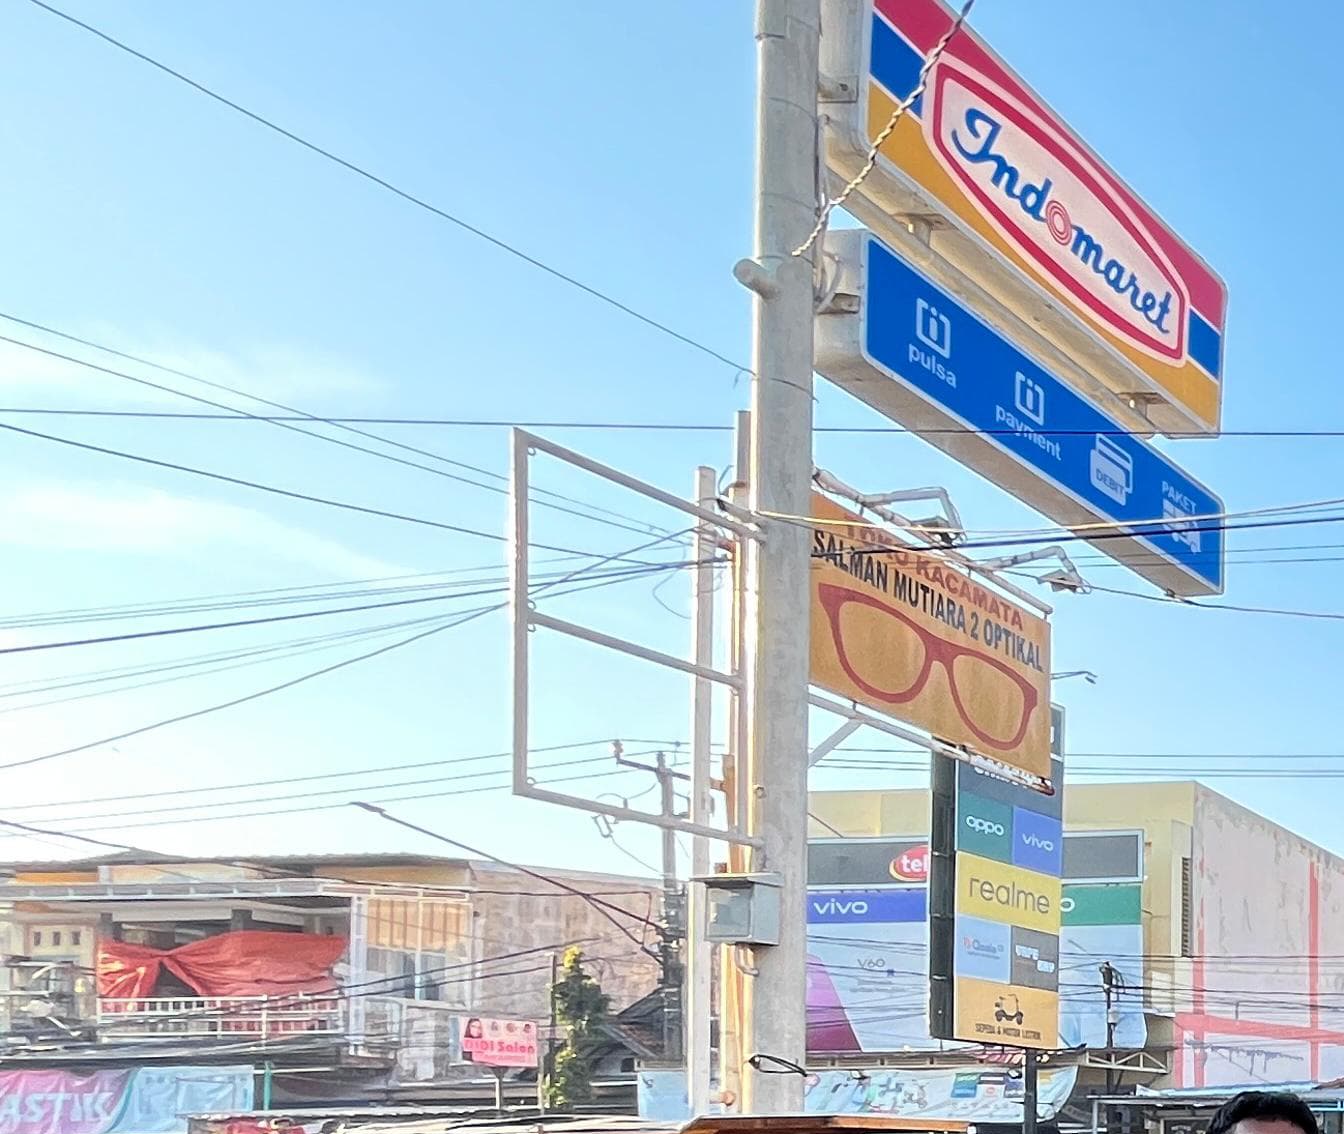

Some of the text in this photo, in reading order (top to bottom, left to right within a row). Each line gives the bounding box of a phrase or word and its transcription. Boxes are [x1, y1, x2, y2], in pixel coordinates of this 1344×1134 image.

[951, 106, 1170, 335] Indomaret
[908, 342, 956, 389] pulsa
[995, 403, 1062, 462] payment
[1095, 468, 1126, 499] DEBIT
[1161, 480, 1197, 515] PAKET
[813, 529, 1044, 673] SALMAN MUTIARA 2 OPTIKAL
[916, 553, 1023, 631] KACAMATA
[965, 815, 1054, 852] oppo vivo
[901, 857, 930, 873] tel
[813, 898, 868, 914] vivo
[969, 876, 1050, 915] realme
